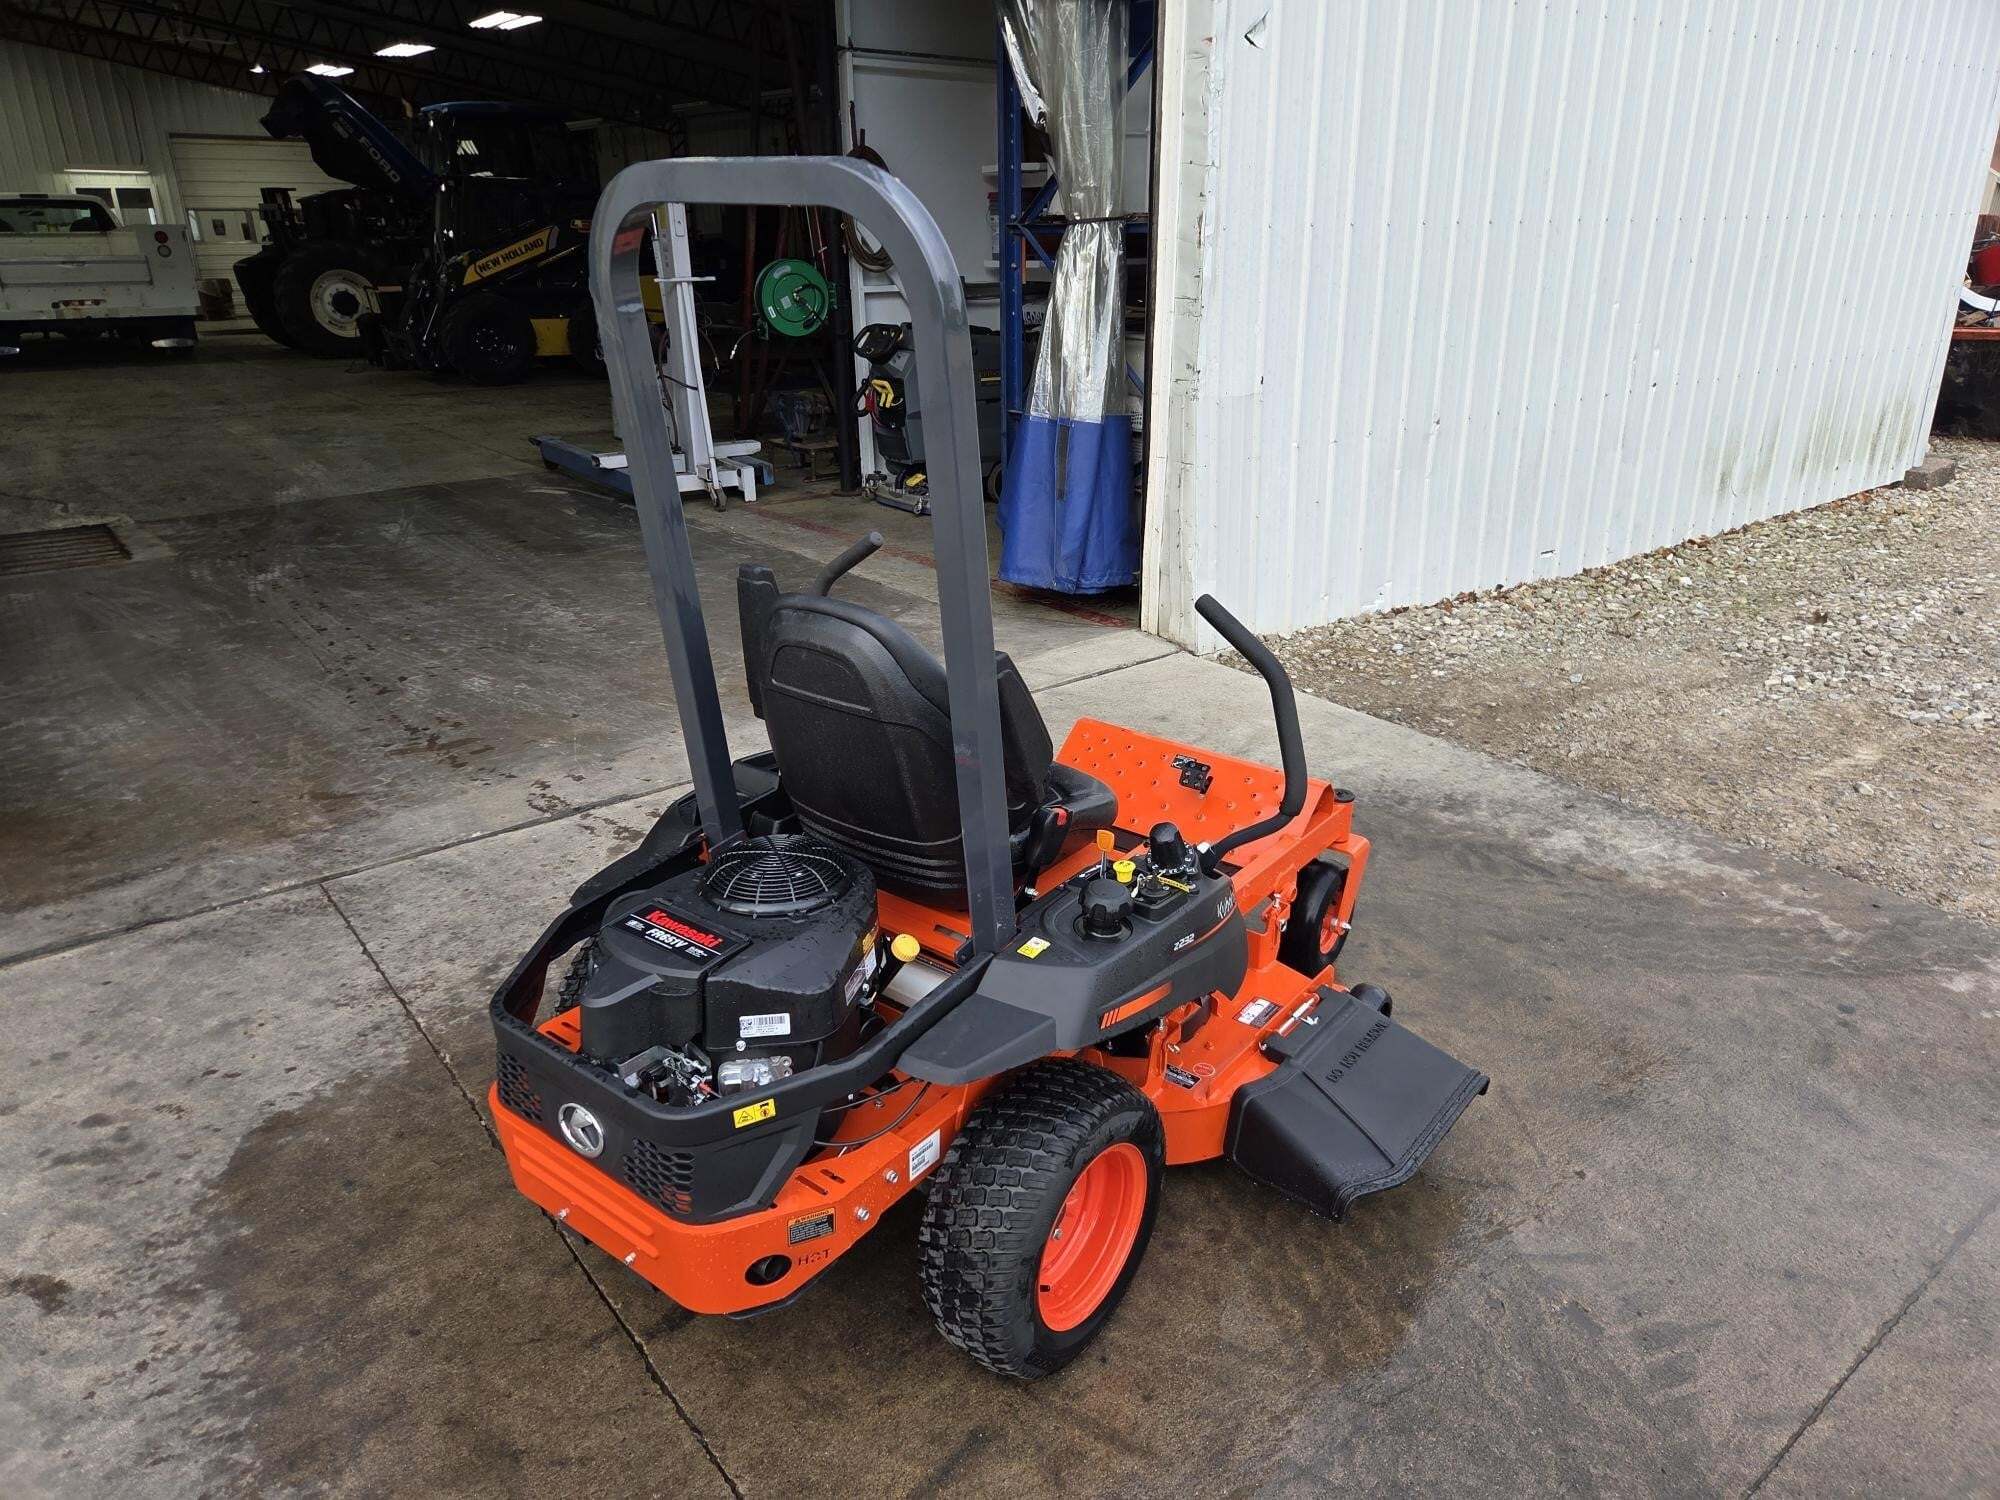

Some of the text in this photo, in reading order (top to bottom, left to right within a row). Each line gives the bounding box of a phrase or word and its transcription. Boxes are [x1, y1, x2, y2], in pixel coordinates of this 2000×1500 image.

[477, 238, 544, 273] NEW HOLLAND
[646, 910, 724, 948] Kawasaki
[798, 1247, 831, 1266] HOT
